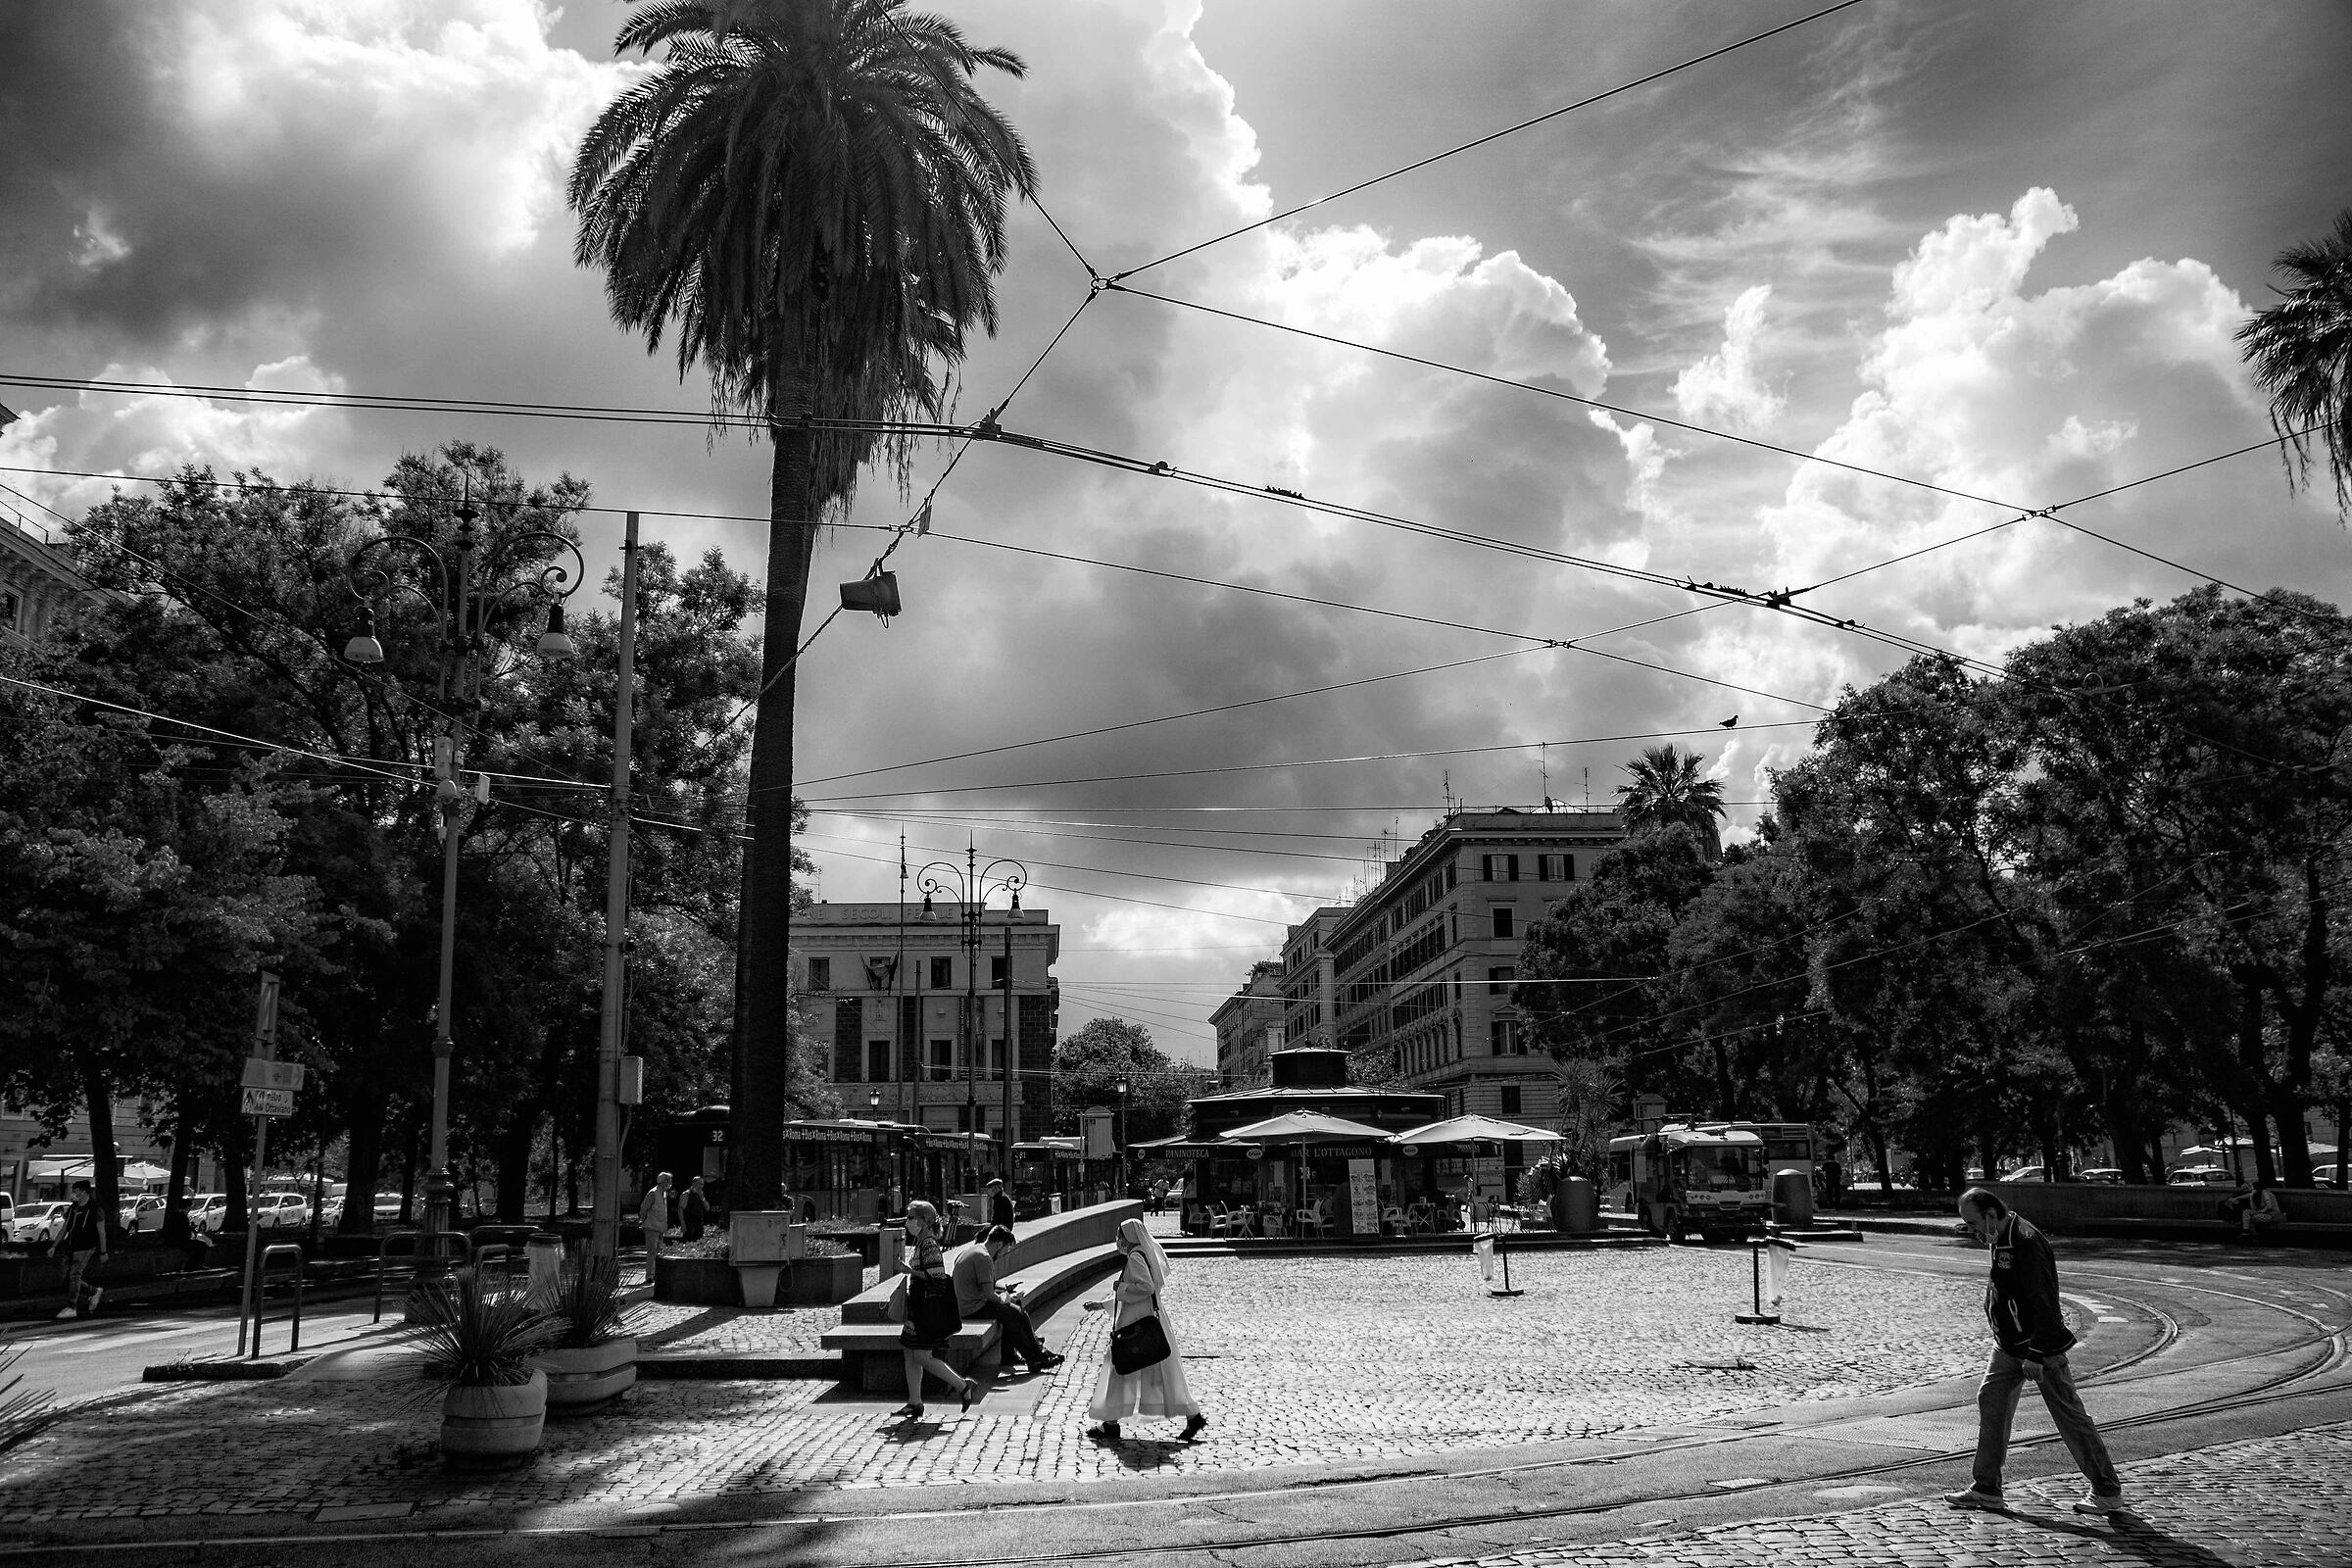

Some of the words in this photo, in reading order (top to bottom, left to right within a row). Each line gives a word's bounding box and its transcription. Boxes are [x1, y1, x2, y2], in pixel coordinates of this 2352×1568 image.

[842, 908, 894, 920] SECOLI
[905, 908, 954, 919] FELE
[266, 1102, 291, 1113] Ottaviano
[711, 1129, 724, 1142] 32
[1164, 1148, 1209, 1158] PANINOTECA
[1290, 1149, 1309, 1157] BAR
[1313, 1147, 1372, 1157] L'OTTAGONO
